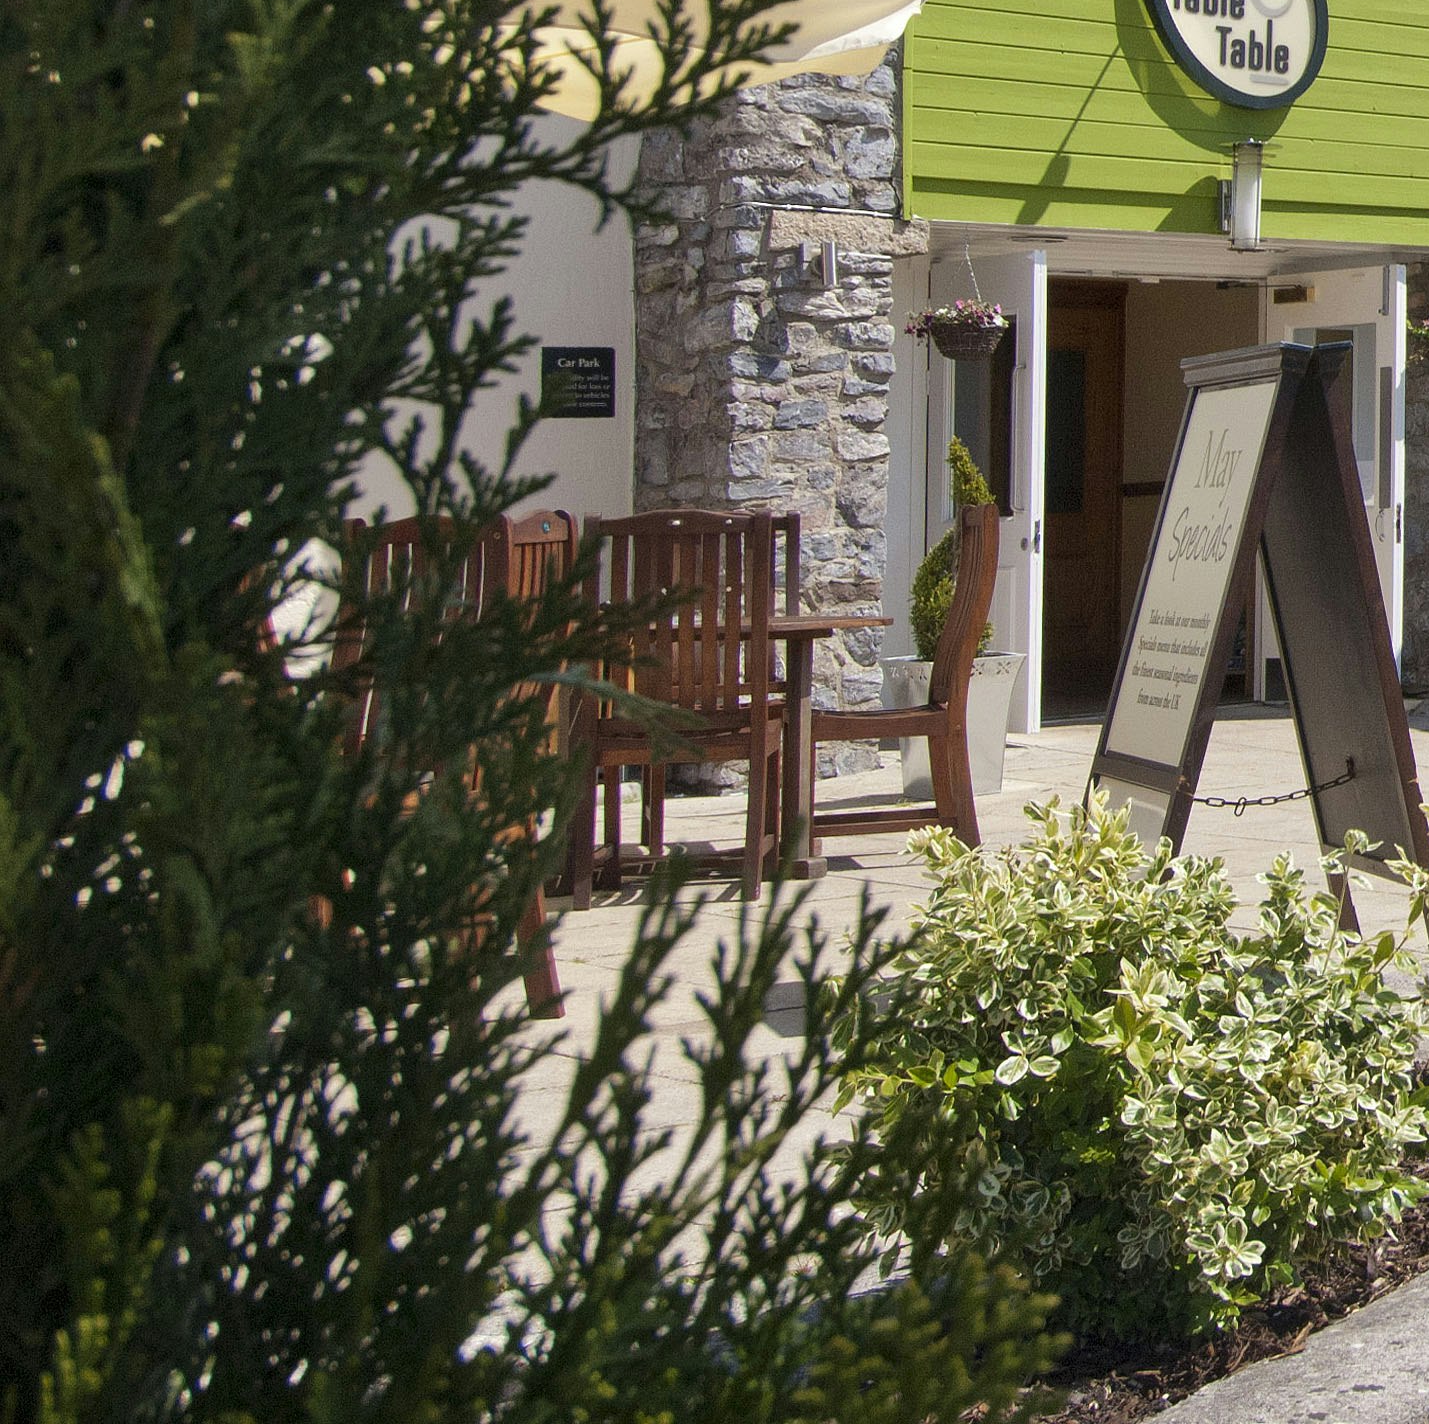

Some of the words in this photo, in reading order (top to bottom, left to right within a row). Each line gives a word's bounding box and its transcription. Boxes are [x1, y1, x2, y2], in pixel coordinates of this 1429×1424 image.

[1215, 19, 1290, 74] Table
[557, 357, 576, 368] Car
[578, 357, 600, 368] Park
[1194, 428, 1242, 508] May
[1168, 506, 1232, 582] Specials
[1149, 609, 1161, 625] Take
[1164, 611, 1176, 626] look
[1175, 616, 1182, 627] at
[1189, 613, 1211, 633] monthly
[1138, 635, 1157, 654] Specials
[1170, 639, 1181, 654] that
[1180, 639, 1200, 656] includes
[1132, 660, 1140, 676] the
[1136, 688, 1149, 705] from
[1148, 696, 1163, 707] across
[1162, 692, 1171, 709] the
[1170, 694, 1182, 710] UK
